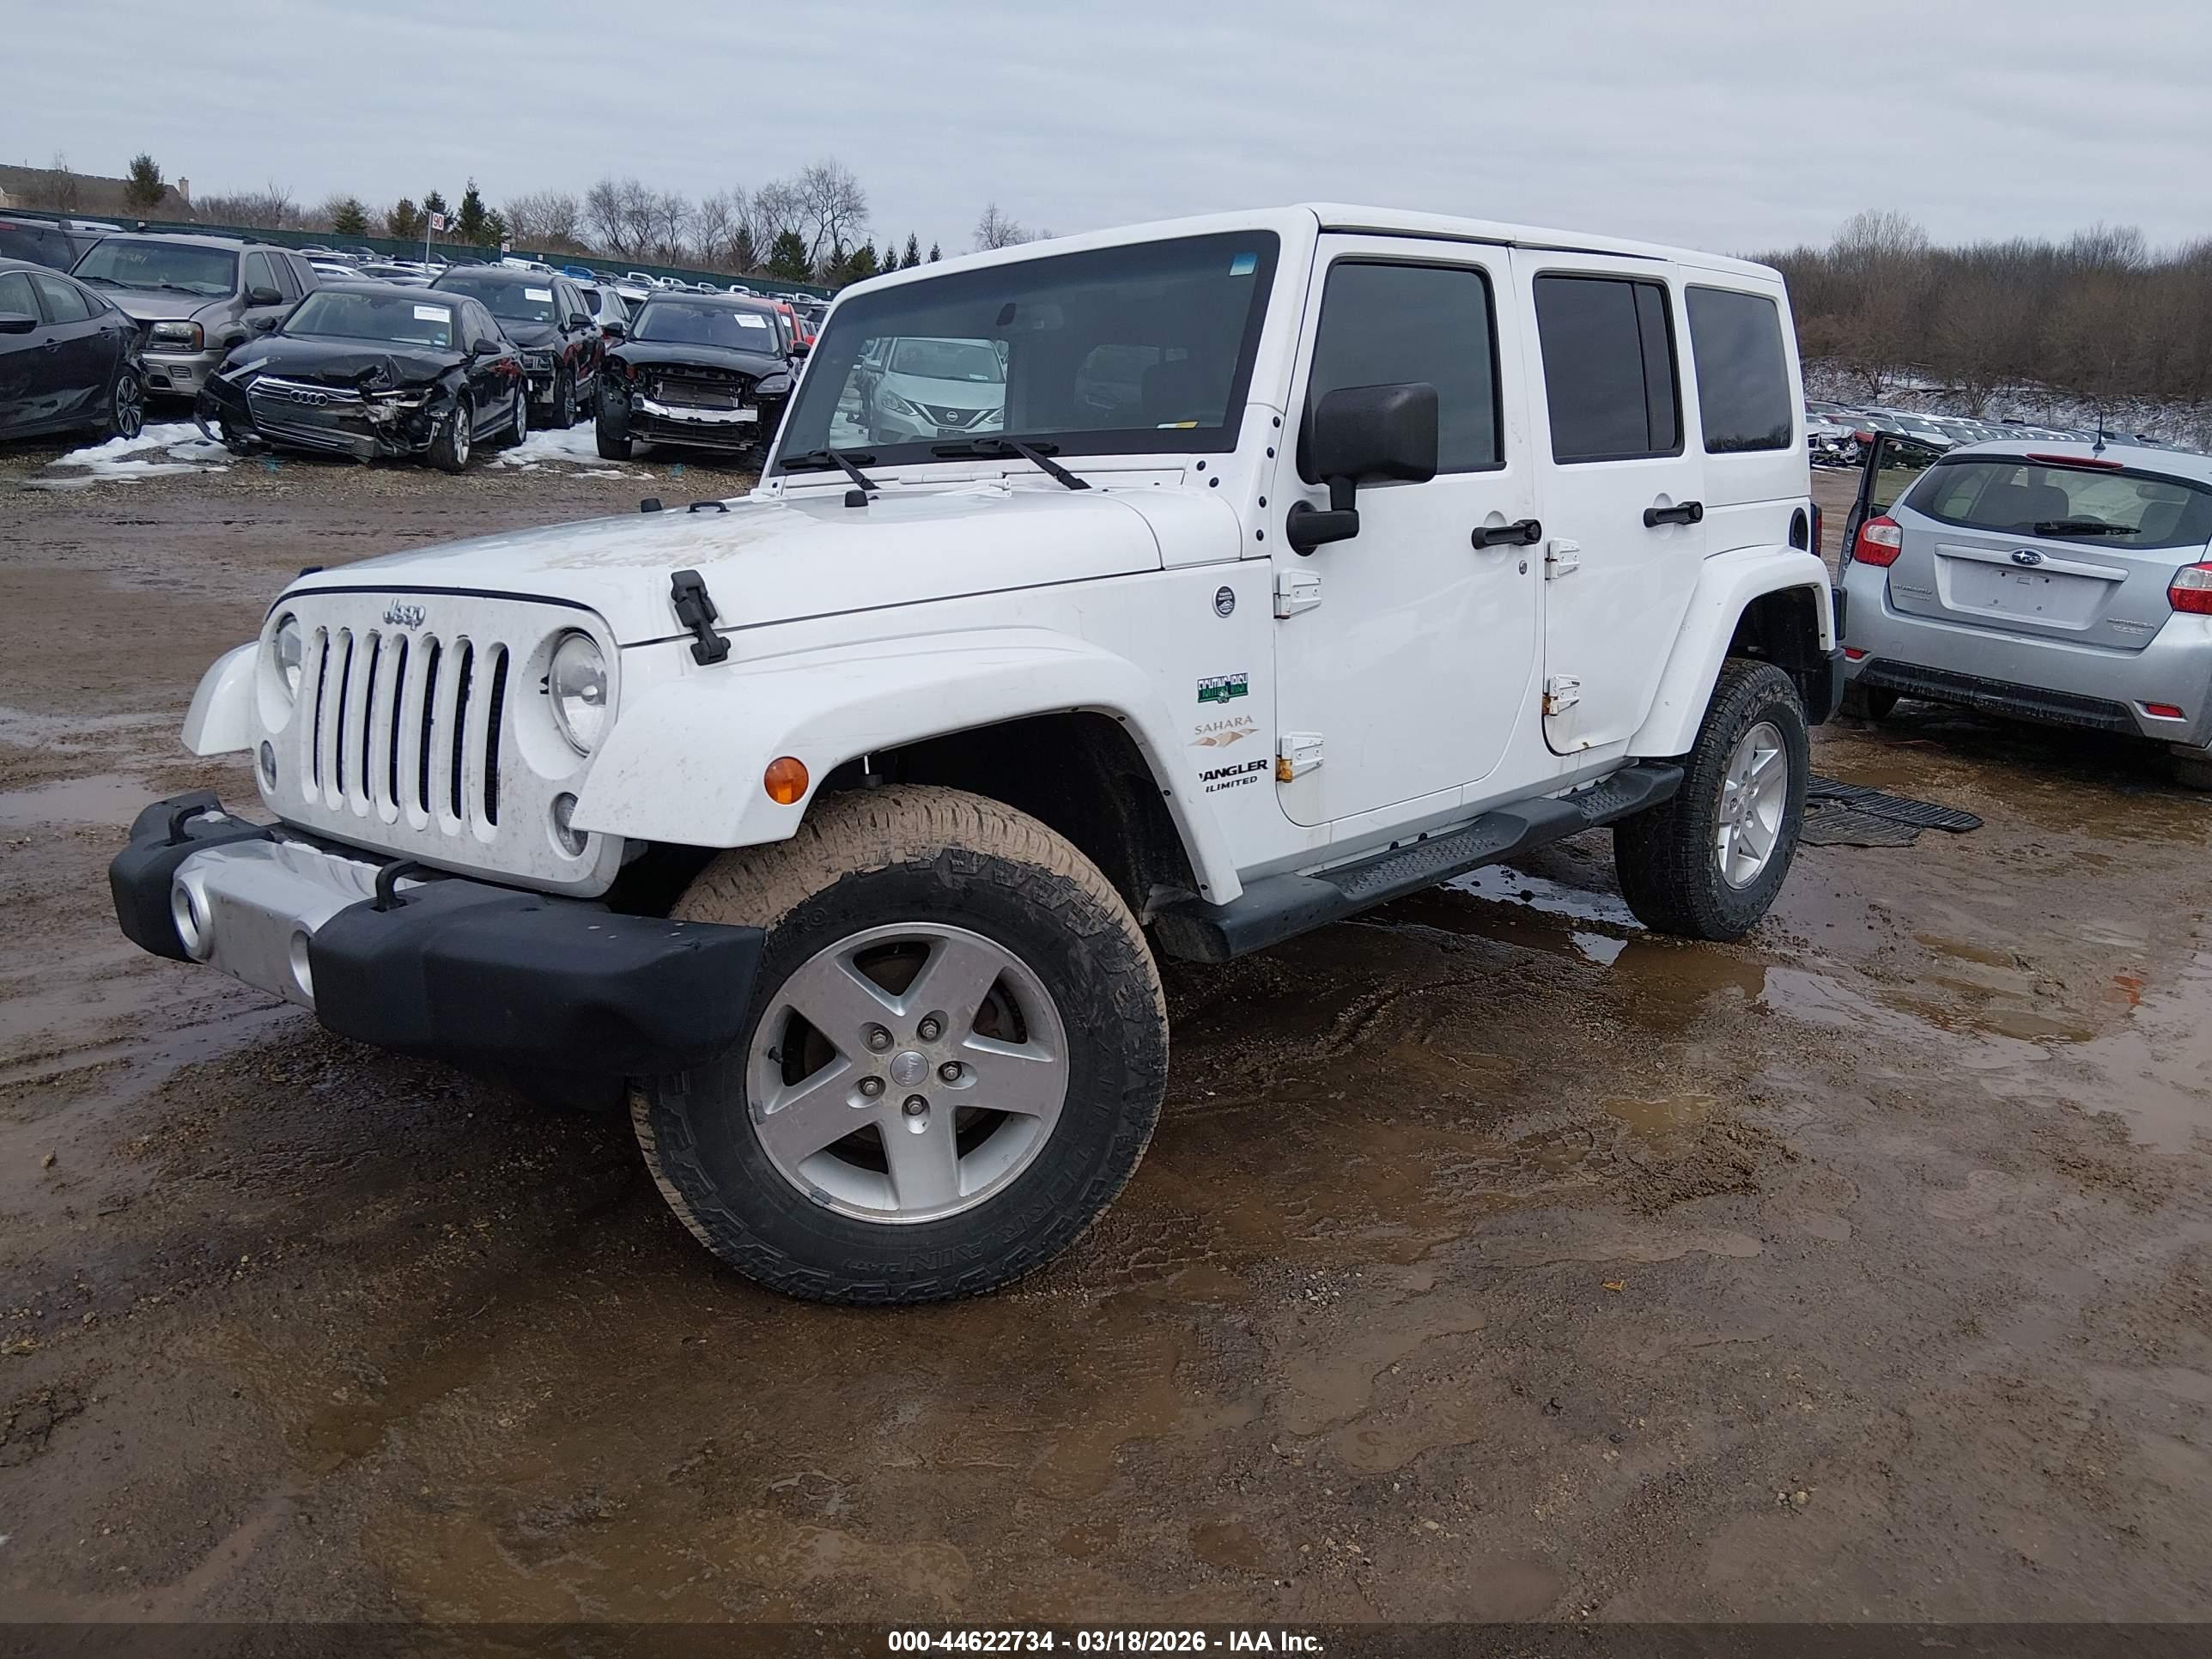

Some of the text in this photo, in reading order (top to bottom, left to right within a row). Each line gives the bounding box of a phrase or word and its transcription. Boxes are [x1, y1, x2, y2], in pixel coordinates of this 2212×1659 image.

[433, 216, 443, 228] 90
[383, 598, 426, 631] Jeep
[1194, 714, 1254, 735] SAHARA
[1199, 759, 1268, 782] ANGLER
[1205, 775, 1258, 793] LIMITED
